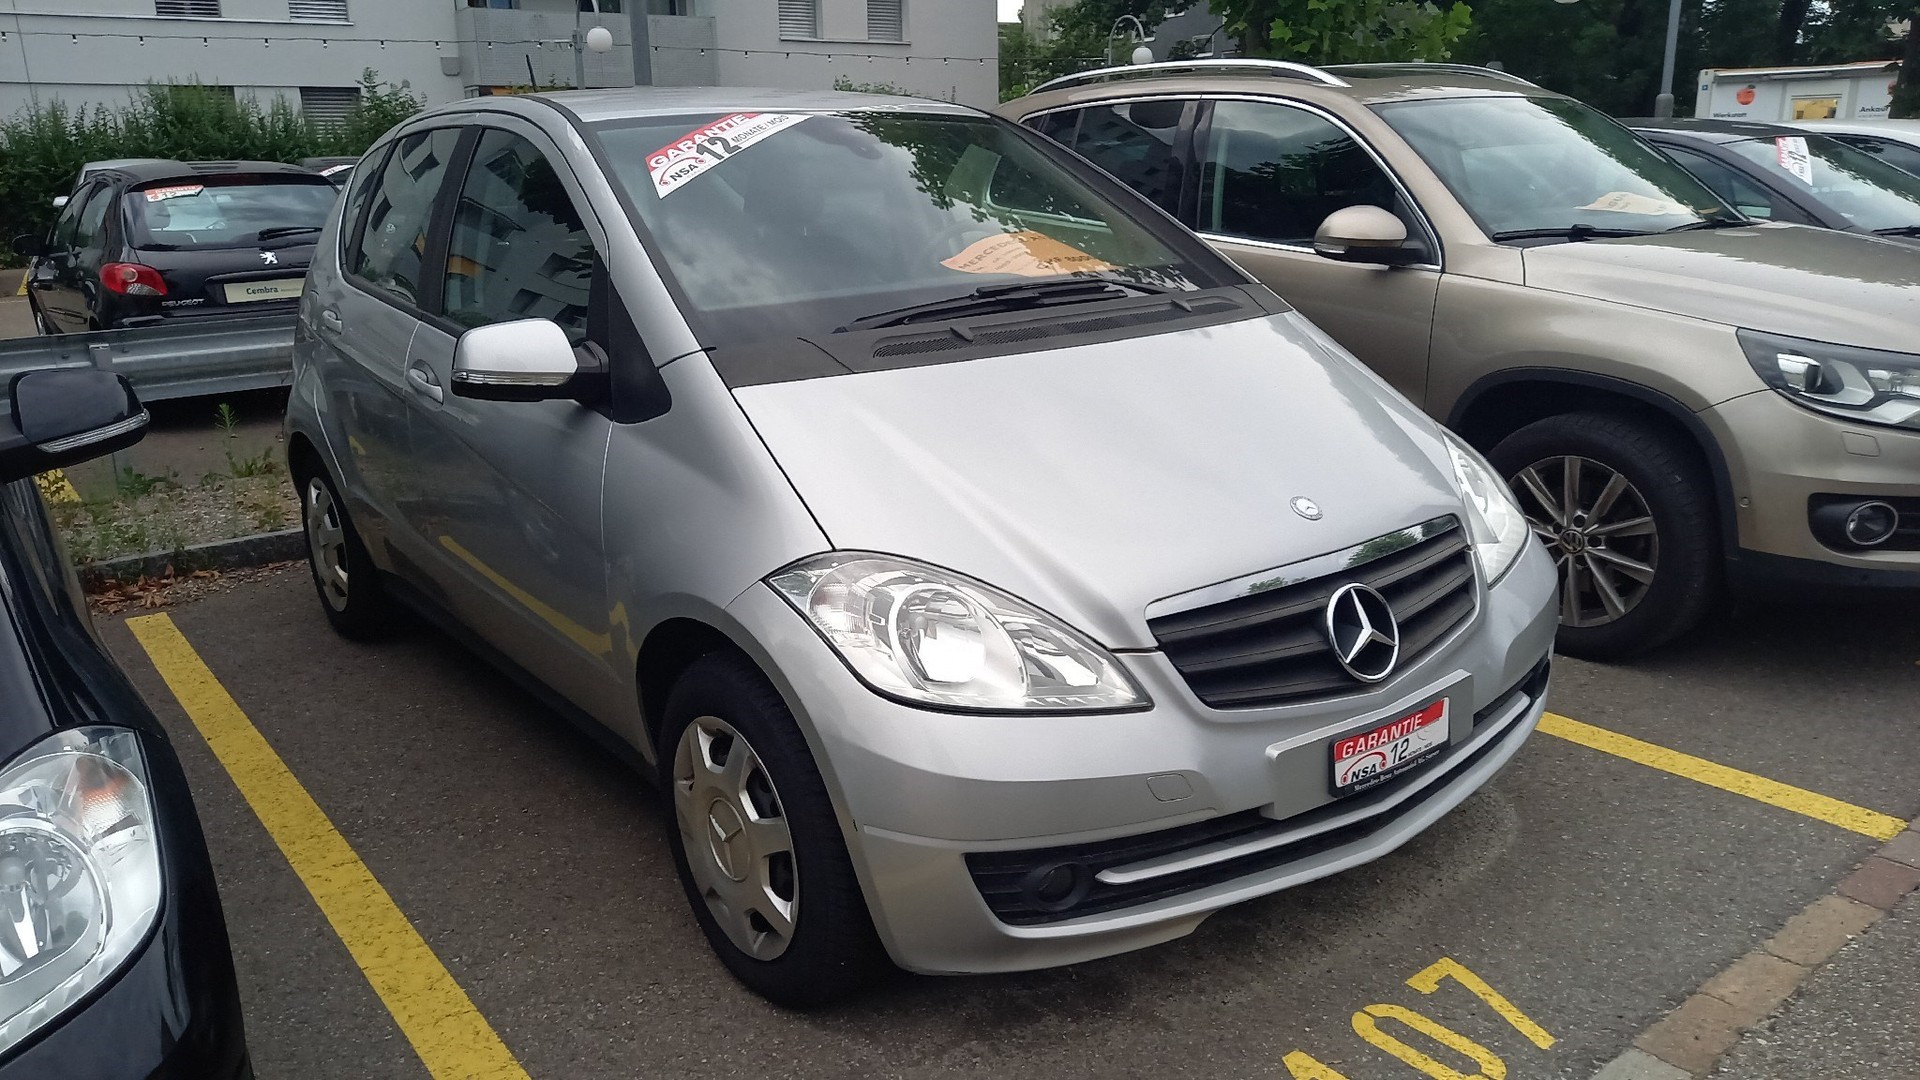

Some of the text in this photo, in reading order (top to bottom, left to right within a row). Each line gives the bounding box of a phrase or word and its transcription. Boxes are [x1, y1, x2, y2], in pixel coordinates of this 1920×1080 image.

[650, 113, 750, 168] GARANTIE
[669, 163, 698, 182] NSA
[696, 136, 742, 161] 12
[731, 123, 765, 144] MONATE
[161, 298, 205, 307] PEUGEOT
[246, 285, 279, 295] Cembra
[1342, 713, 1423, 758] GARANTIE
[1350, 763, 1377, 783] NSA
[1390, 737, 1410, 765] 12
